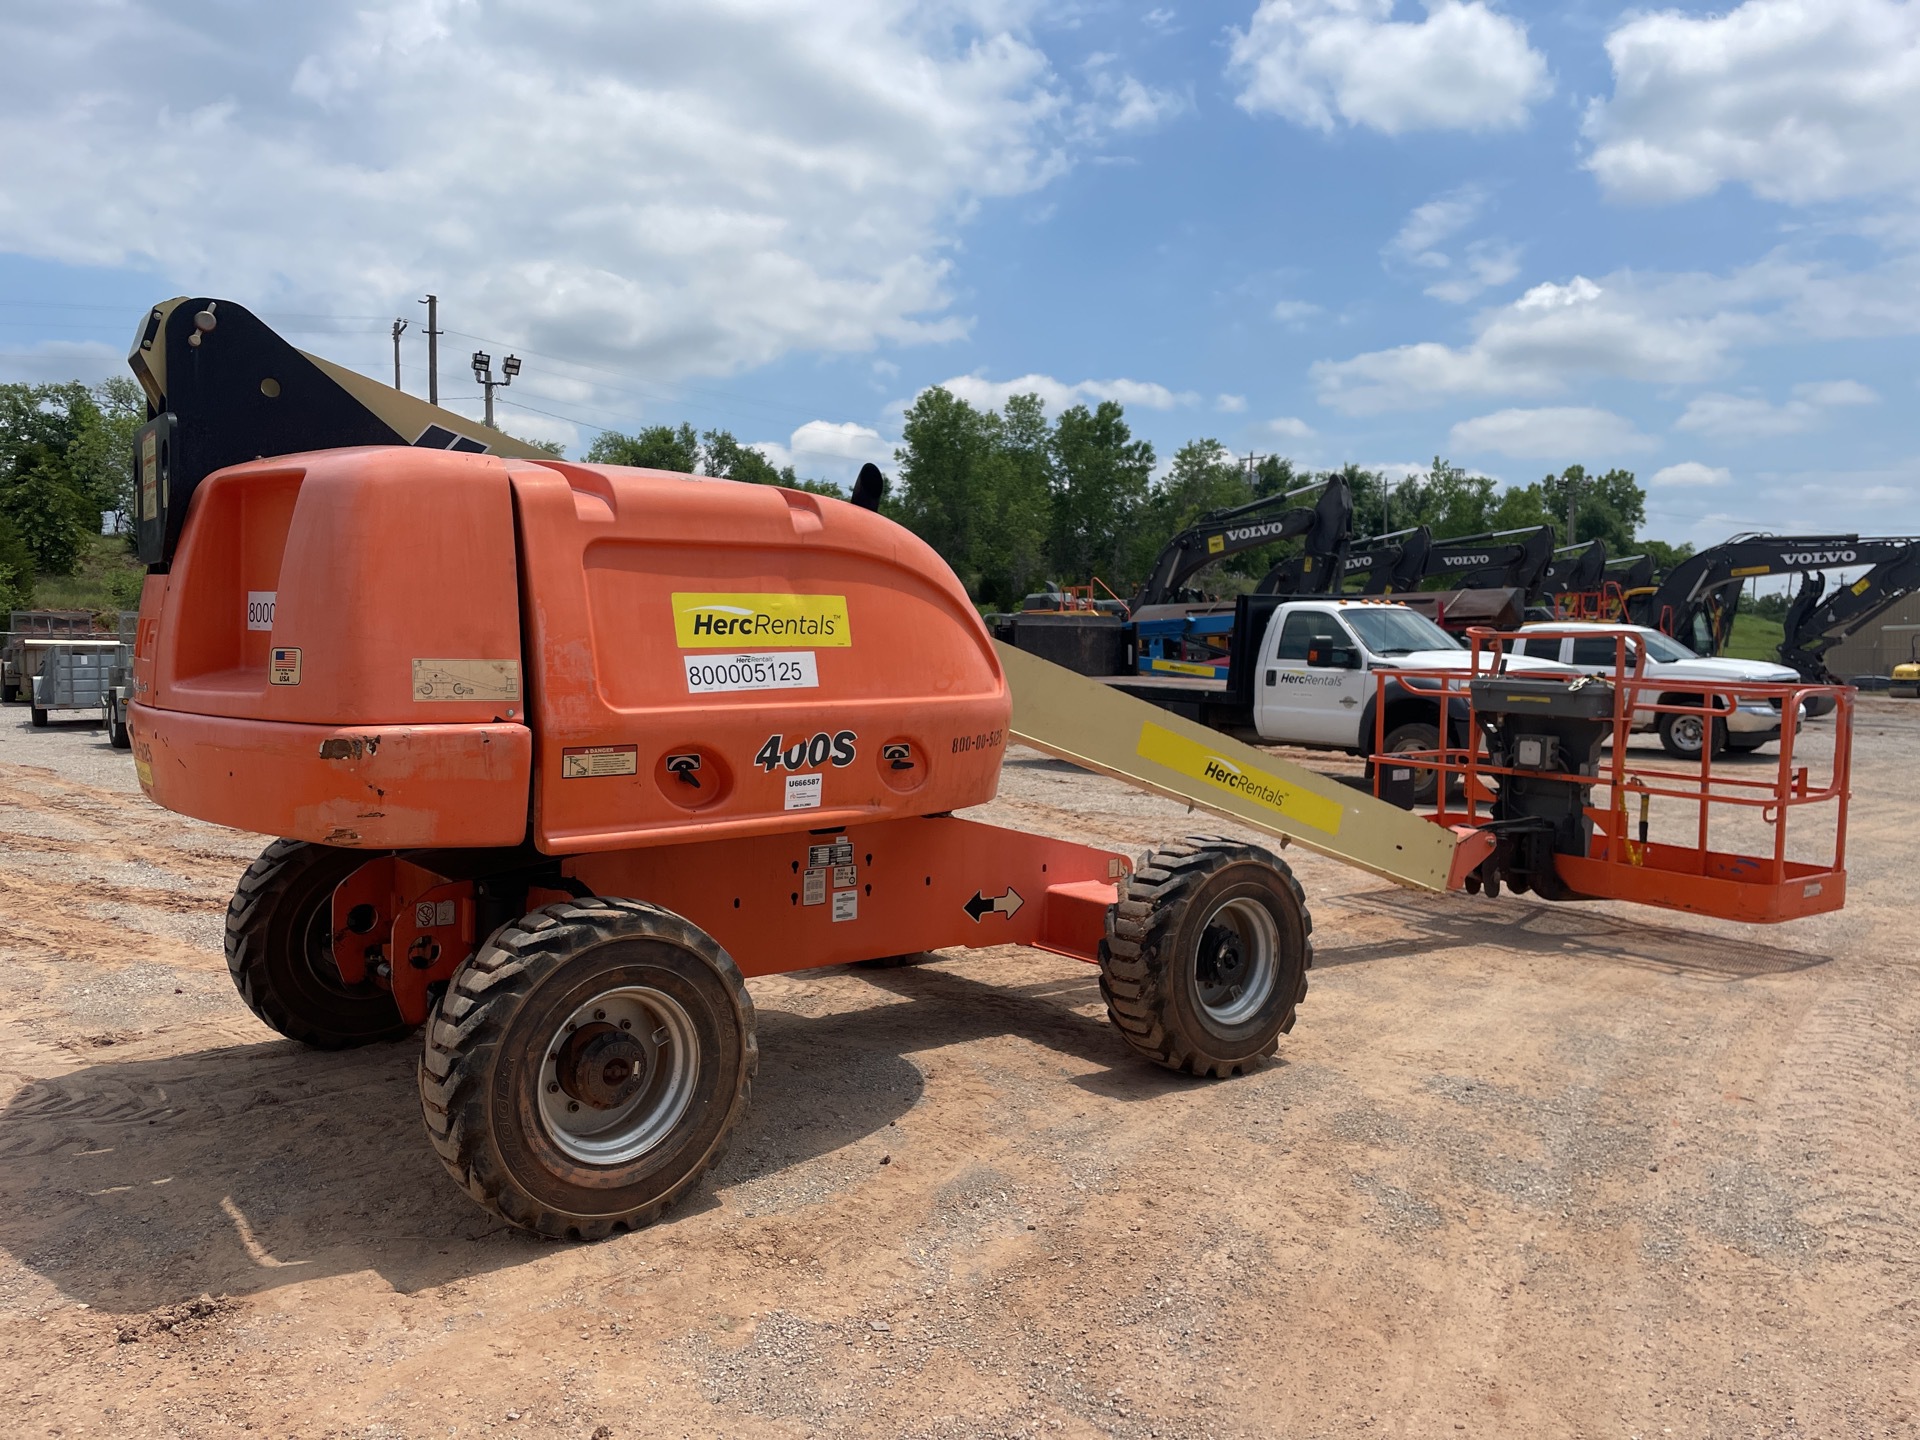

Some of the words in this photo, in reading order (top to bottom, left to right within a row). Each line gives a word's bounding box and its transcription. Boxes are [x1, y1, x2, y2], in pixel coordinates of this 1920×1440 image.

[1226, 522, 1283, 541] VOLVO
[1443, 555, 1489, 566] VOLVO
[1780, 550, 1857, 565] VOLVO
[689, 662, 802, 686] 800005125
[754, 729, 859, 774] 400S
[789, 778, 820, 787] U666587
